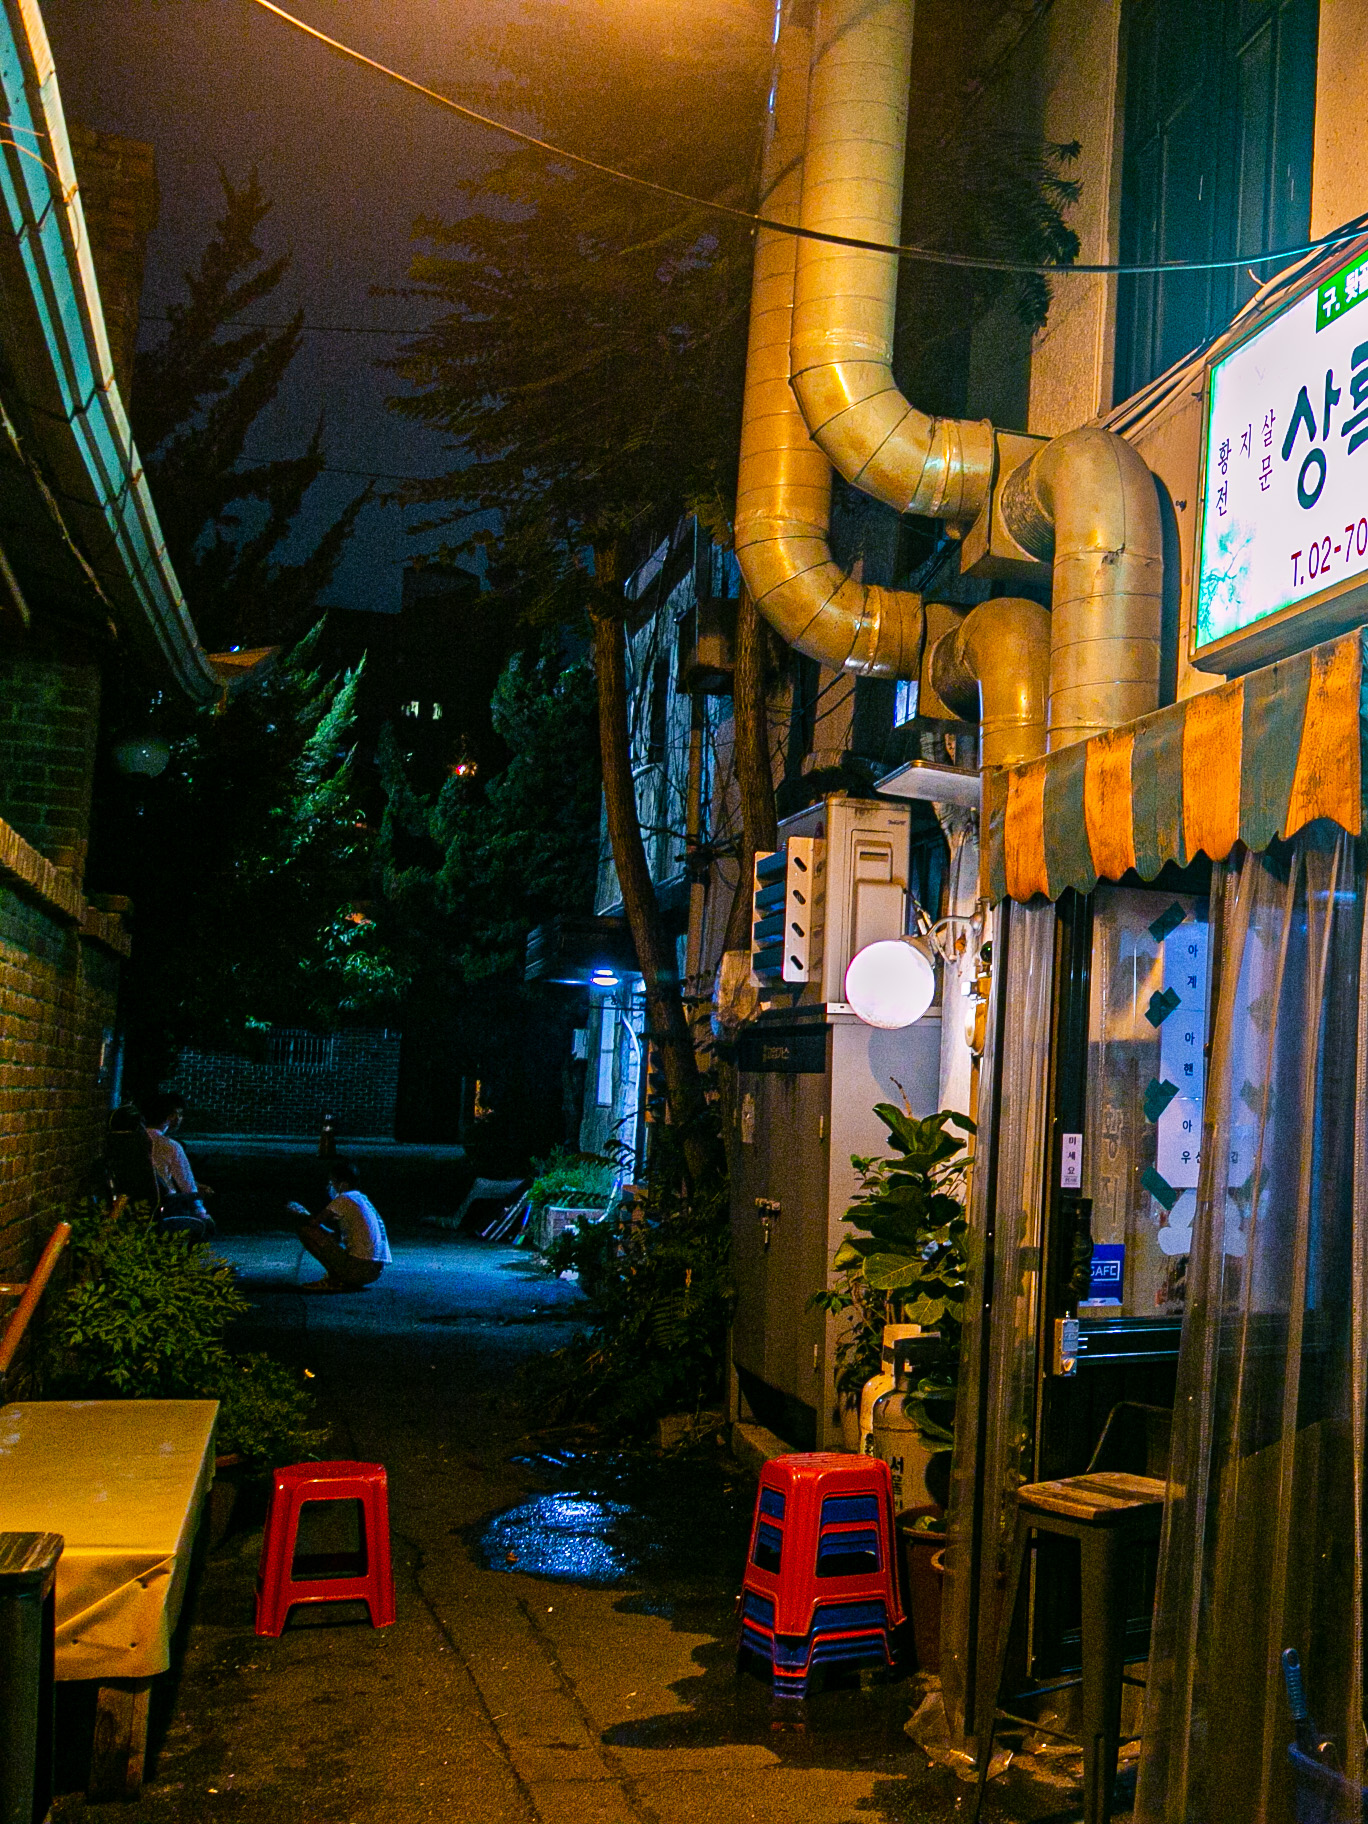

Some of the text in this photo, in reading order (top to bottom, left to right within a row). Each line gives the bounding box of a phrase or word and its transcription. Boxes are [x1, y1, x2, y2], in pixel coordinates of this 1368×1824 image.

[1322, 286, 1341, 317] 구.
[1188, 944, 1199, 958] 아
[1185, 1031, 1196, 1046] 아
[1182, 1119, 1193, 1133] 아
